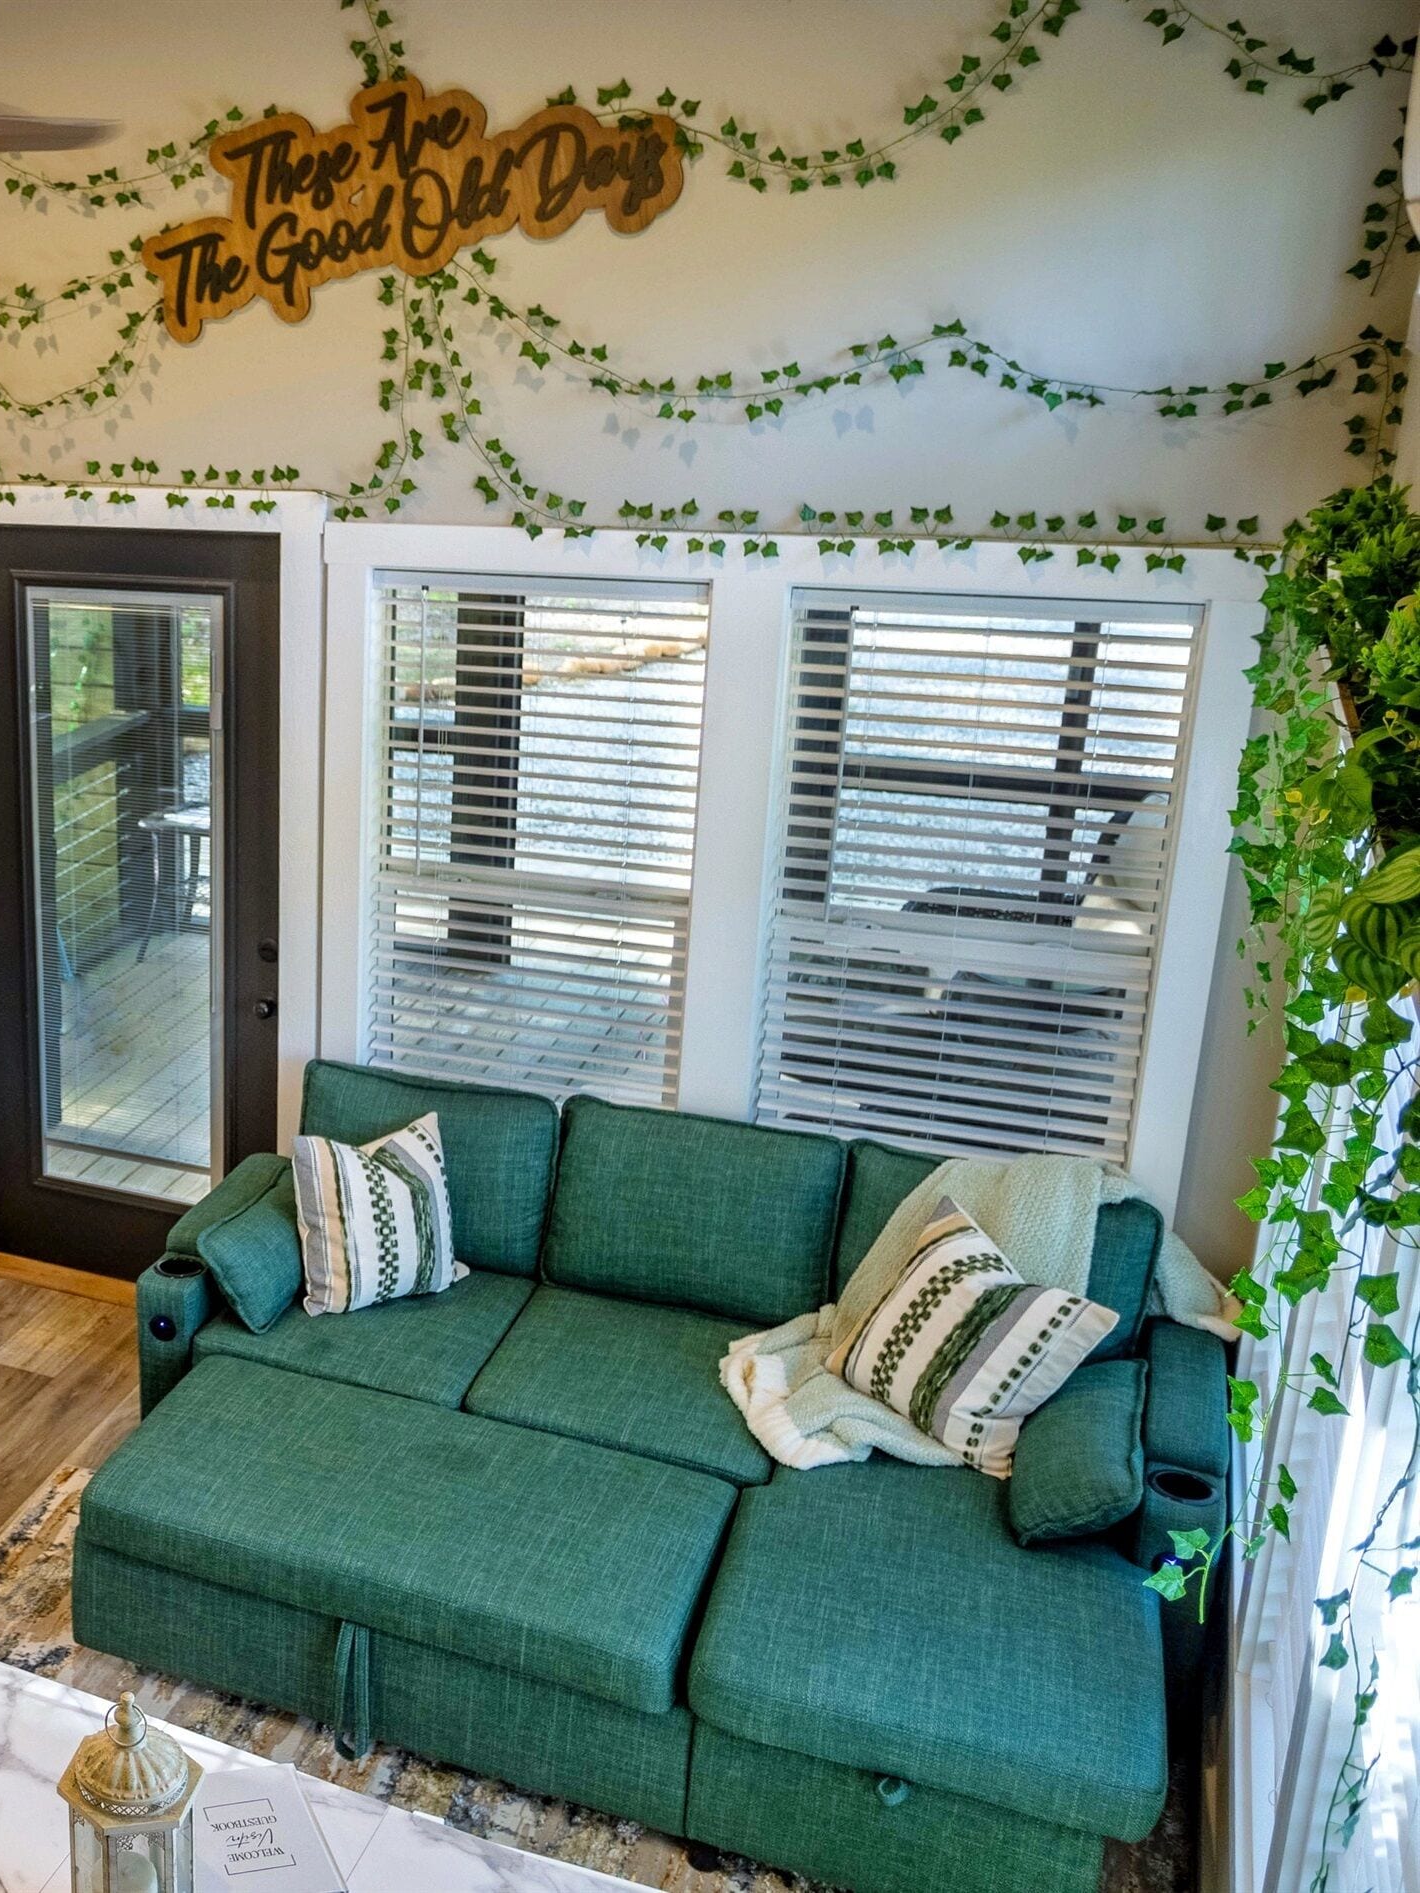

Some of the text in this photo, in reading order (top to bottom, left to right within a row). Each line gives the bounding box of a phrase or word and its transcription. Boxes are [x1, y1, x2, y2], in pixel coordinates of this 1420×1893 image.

[223, 91, 471, 229] These Are
[155, 121, 668, 328] The Good Old Days
[211, 1815, 278, 1832] GUESTBOOK
[225, 1827, 274, 1848] Visitor
[226, 1846, 285, 1863] WELCOME
